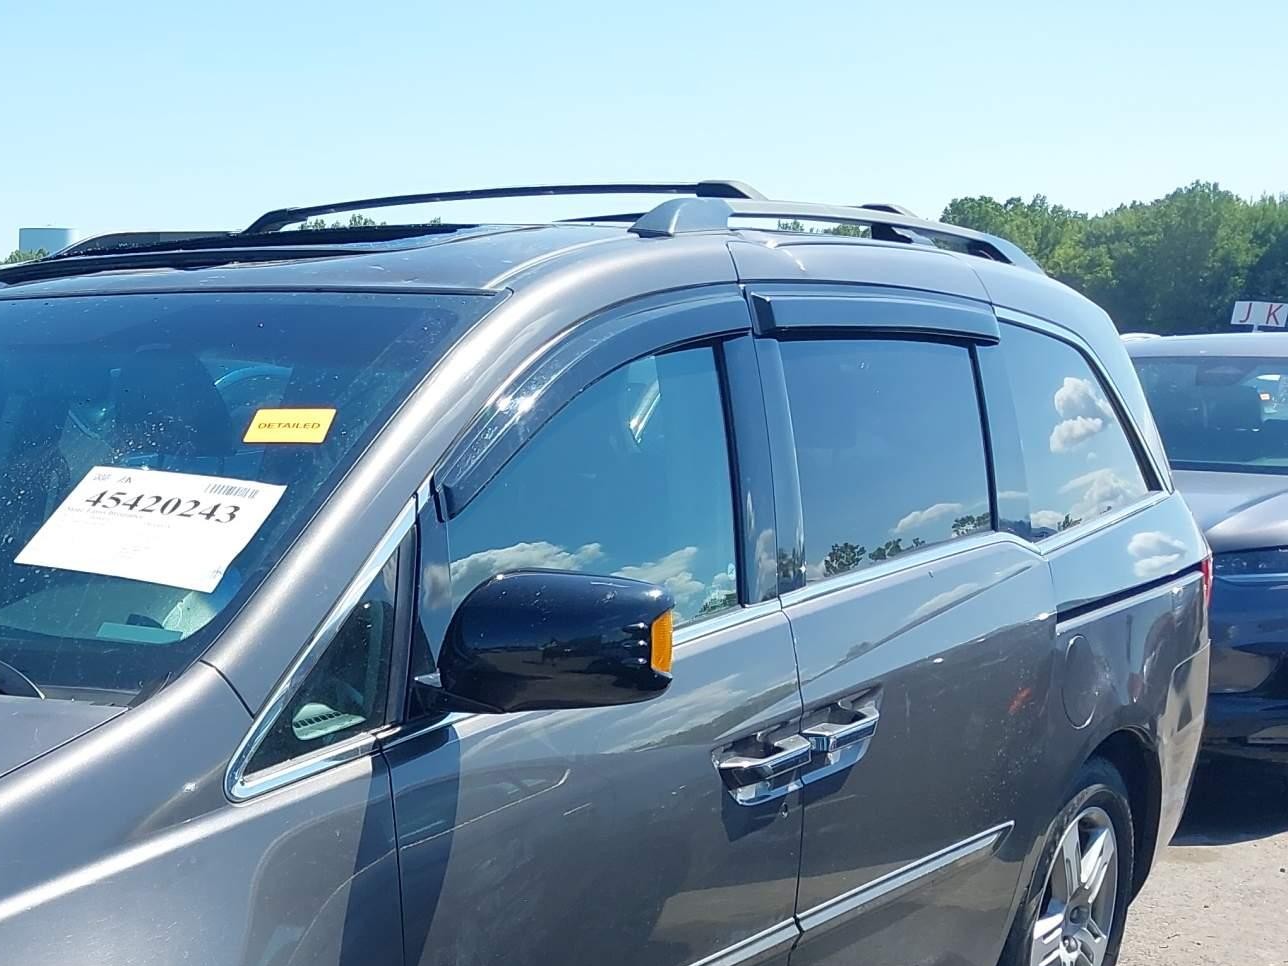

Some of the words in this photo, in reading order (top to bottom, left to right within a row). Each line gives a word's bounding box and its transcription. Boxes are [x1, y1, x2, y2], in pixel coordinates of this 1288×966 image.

[1239, 302, 1253, 323] J
[1265, 303, 1284, 325] K
[257, 421, 321, 430] DETAILED
[84, 488, 241, 524] 45420243
